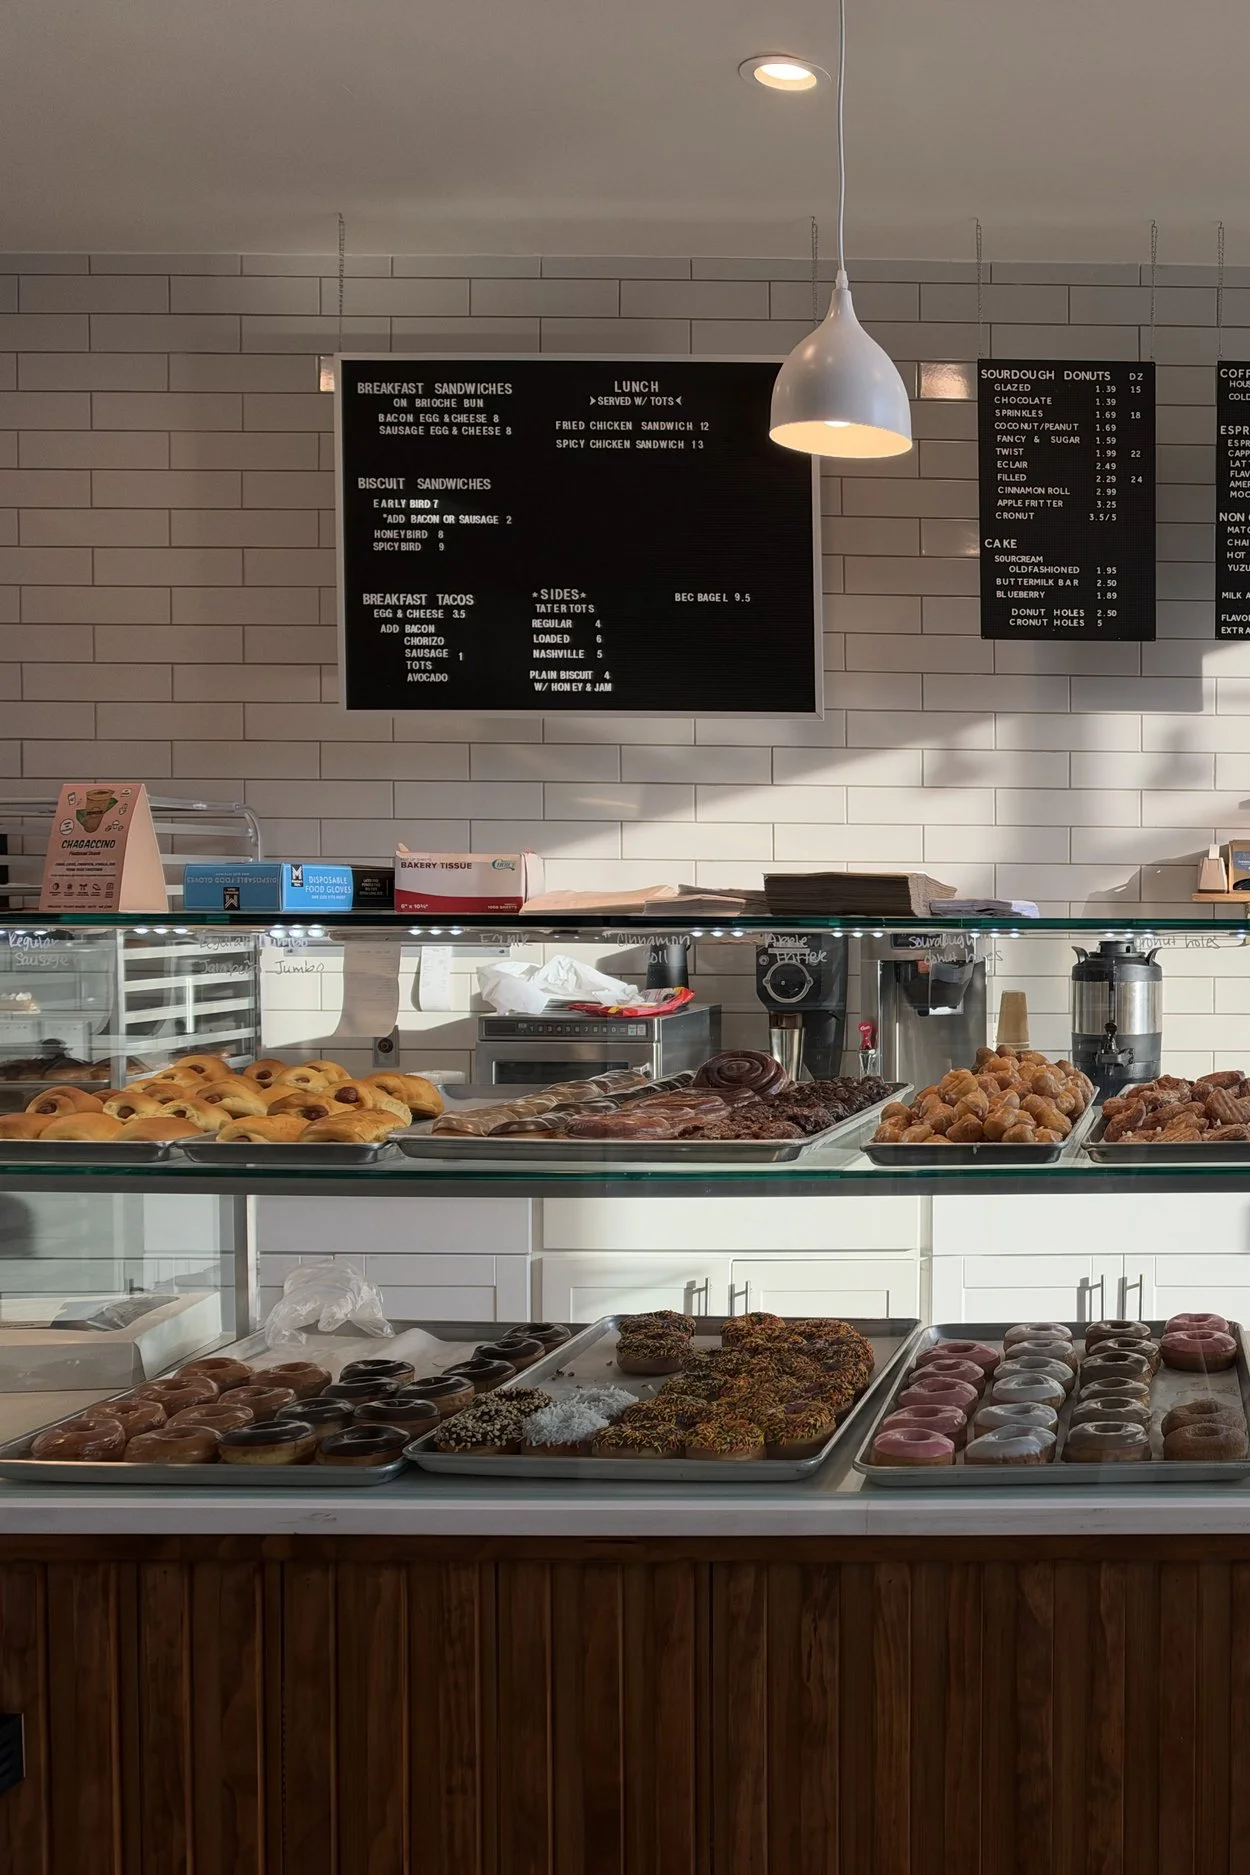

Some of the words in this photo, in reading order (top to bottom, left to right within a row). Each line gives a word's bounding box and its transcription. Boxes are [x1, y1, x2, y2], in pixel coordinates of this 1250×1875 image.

[981, 369, 1055, 380] SOURDOUGH
[1064, 371, 1111, 381] DONUTS
[357, 382, 424, 394] BREAKFAST
[434, 383, 513, 395] SANDWICHES
[614, 381, 659, 393] LUNCH
[1095, 385, 1117, 393] 1.39
[393, 398, 407, 407] ON
[415, 399, 457, 408] BRIOCHE
[463, 399, 484, 408] BUN
[597, 396, 632, 406] SERVED
[650, 397, 674, 406] TOTS
[994, 397, 1052, 405] CHOCOLATE
[378, 414, 414, 423] BACON
[420, 414, 440, 423] EGG
[995, 409, 1043, 417] SPRINKLES
[1095, 411, 1117, 419] 1.69
[555, 421, 585, 430] FRIED
[589, 421, 632, 430] CHICKEN
[641, 421, 693, 431] SANDWICH
[700, 422, 709, 431] 12
[379, 426, 425, 435] SAUSAGE
[429, 426, 449, 435] EGG
[461, 426, 501, 436] CHEESE
[997, 435, 1026, 443] FANCY
[1050, 436, 1080, 444] SUGAR
[556, 440, 585, 449] SPICY
[589, 440, 631, 449] CHICKEN
[635, 440, 684, 449] SANDWICH
[995, 448, 1024, 456] TWIST
[997, 461, 1028, 469] ECLAIR
[358, 477, 406, 489] BISCUIT
[417, 478, 492, 490] SANDWICHES
[1047, 487, 1070, 495] ROLL
[373, 499, 406, 508] EARLY
[409, 499, 431, 508] BIRD
[1025, 500, 1063, 508] FRITTER
[410, 514, 440, 524] BACON
[442, 515, 455, 524] OR
[458, 515, 499, 525] SAUSAGE
[995, 512, 1035, 520] CRONUT
[1219, 512, 1245, 522] NON
[984, 539, 1018, 548] CAKE
[996, 578, 1054, 586] BUTTERMILK
[362, 593, 428, 605] BREAKFAST
[436, 594, 474, 605] TACOS
[675, 593, 694, 602] BEC
[697, 593, 728, 602] BAGEL
[996, 591, 1045, 599] BLUEBERRY
[535, 604, 567, 613] TATER
[568, 604, 595, 613] TOTS
[1011, 608, 1046, 616] DONUT
[1053, 609, 1085, 617] HOLES
[373, 609, 393, 618] EGG
[406, 610, 444, 618] CHEESE
[532, 619, 572, 628] REGULAR
[1009, 618, 1048, 626] CRONUT
[1053, 619, 1085, 627] HOLES
[405, 625, 435, 634] BACON
[404, 637, 445, 646] CHORIZO
[533, 634, 570, 643] LOADED
[405, 649, 449, 658] SAUSAGE
[533, 650, 585, 659] NASHVILLE
[406, 661, 433, 670] TOTS
[407, 673, 448, 682] AVOCADO
[529, 671, 557, 679] PLAIN
[559, 671, 593, 680] BISCUIT
[551, 683, 583, 692] HONEY
[594, 683, 612, 692] JAM
[61, 839, 116, 848] CHAGACCINO
[308, 875, 348, 884] DISPOSABLE
[305, 885, 324, 893] FOOD
[326, 885, 352, 894] GLOVES
[1184, 936, 1218, 949] holes
[275, 959, 325, 975] Jumbo
